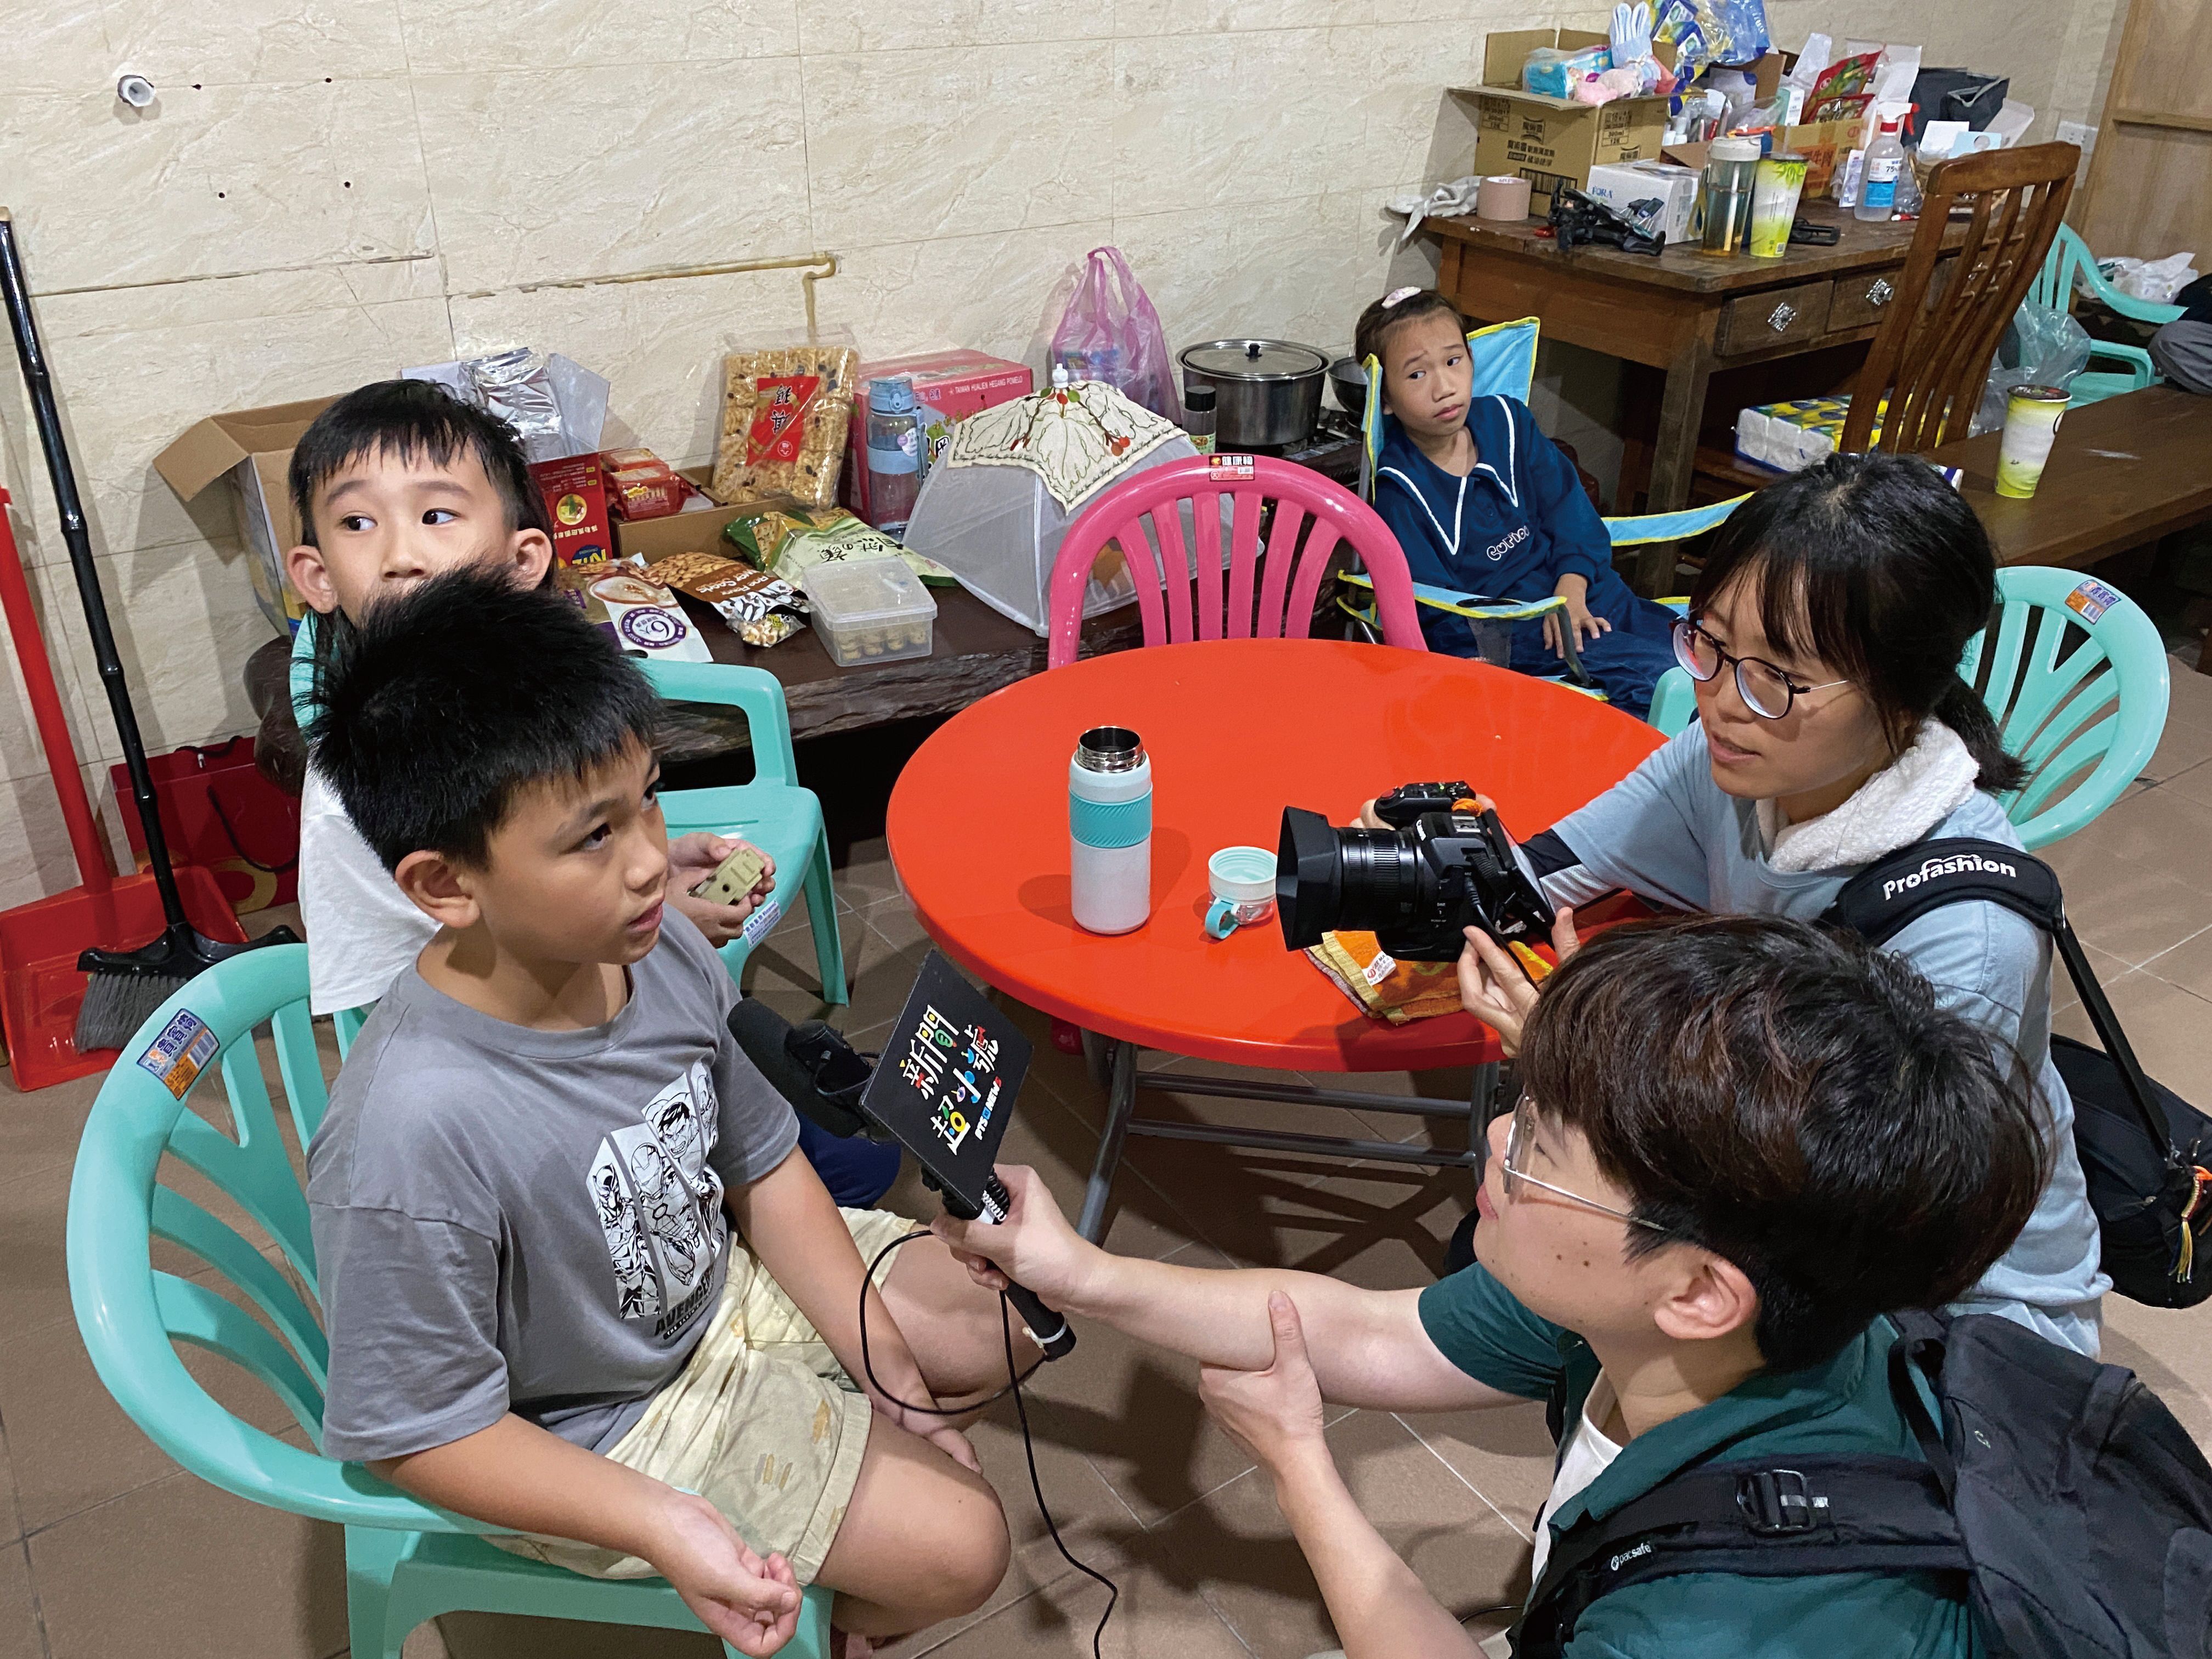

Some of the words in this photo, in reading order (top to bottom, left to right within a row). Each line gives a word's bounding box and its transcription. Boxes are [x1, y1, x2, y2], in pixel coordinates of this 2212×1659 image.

[1592, 185, 1613, 199] FORA
[899, 1004, 960, 1100] 新聞
[930, 1024, 999, 1155] 超小號
[1620, 1541, 1652, 1565] pacsafe
